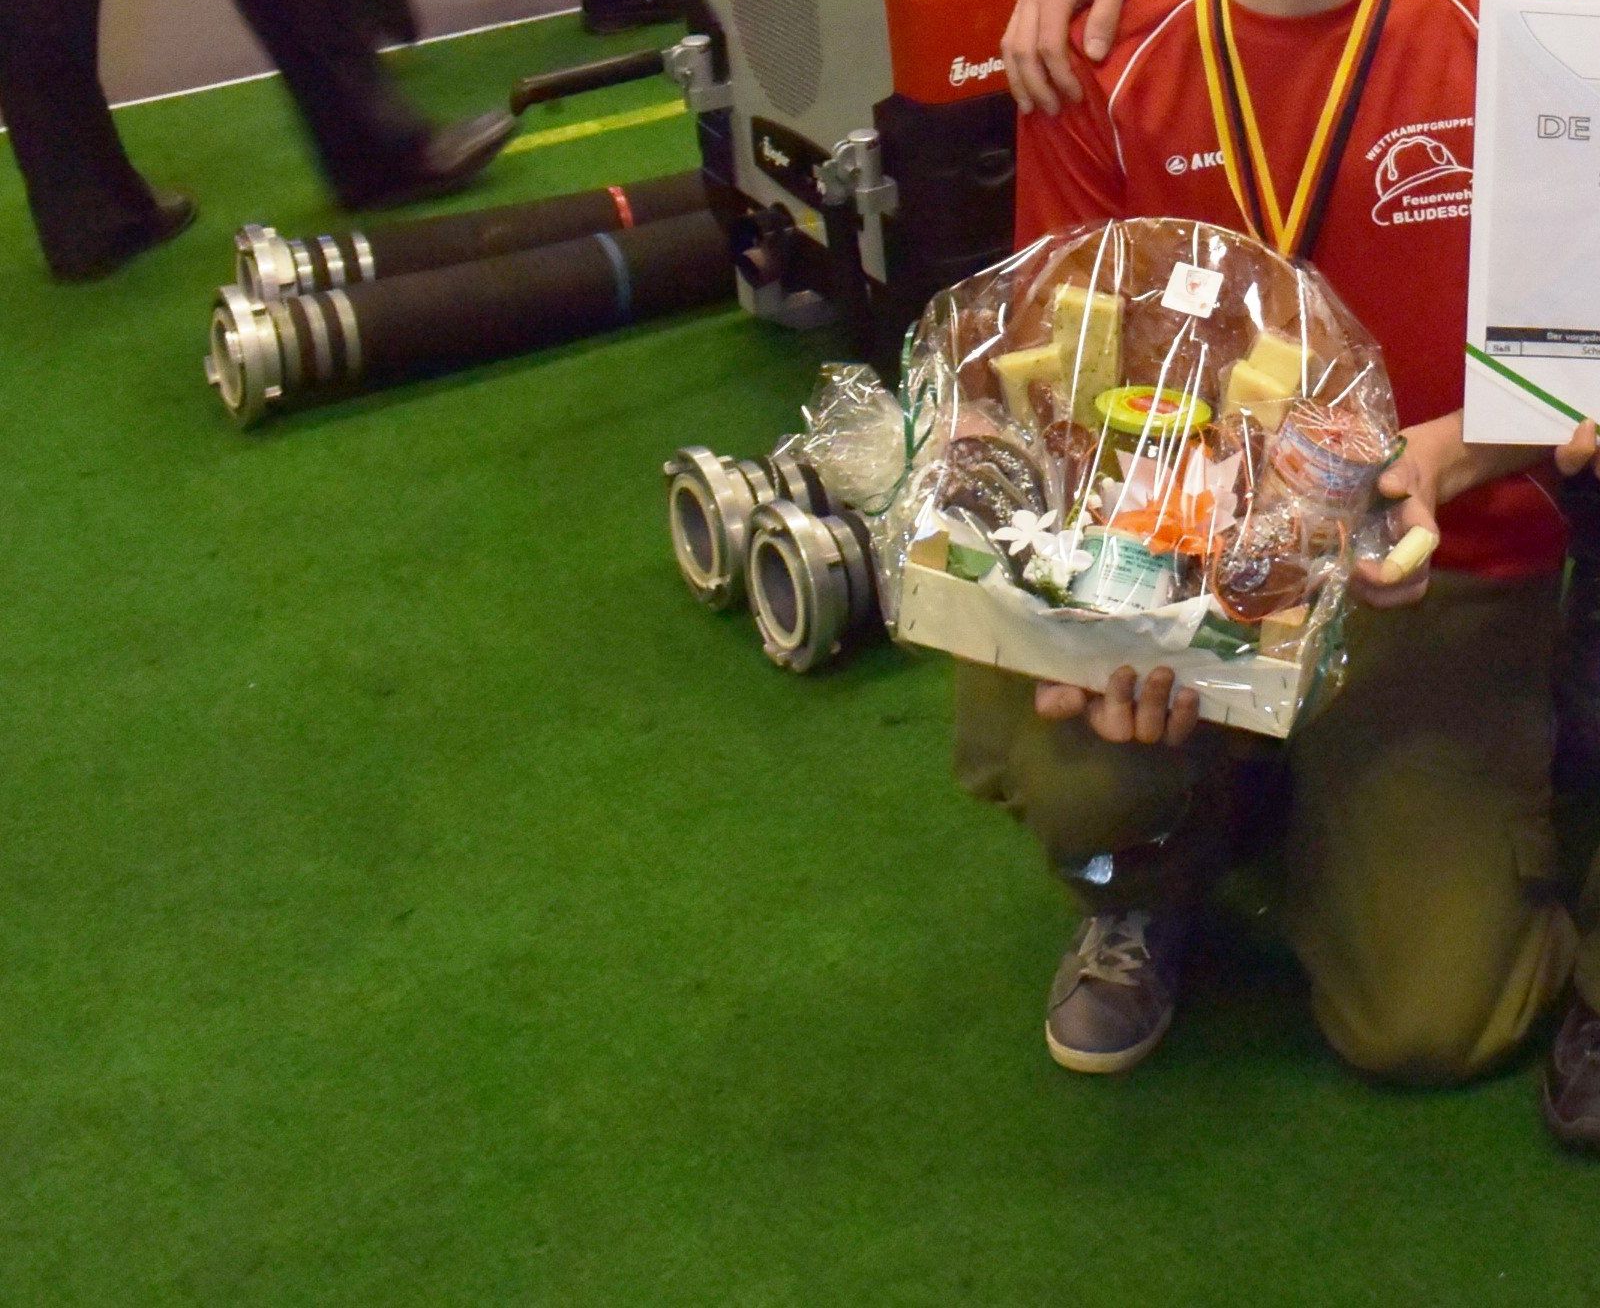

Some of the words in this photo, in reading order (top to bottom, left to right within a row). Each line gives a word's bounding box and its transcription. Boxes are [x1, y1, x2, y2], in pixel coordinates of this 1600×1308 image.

[949, 55, 1004, 87] Ziegle
[1365, 117, 1473, 161] WETTKAMPFGRUPPE
[1537, 114, 1591, 141] DE
[1402, 189, 1473, 206] Feuerweh
[1393, 205, 1472, 224] BLUDESC
[1546, 331, 1562, 341] Der
